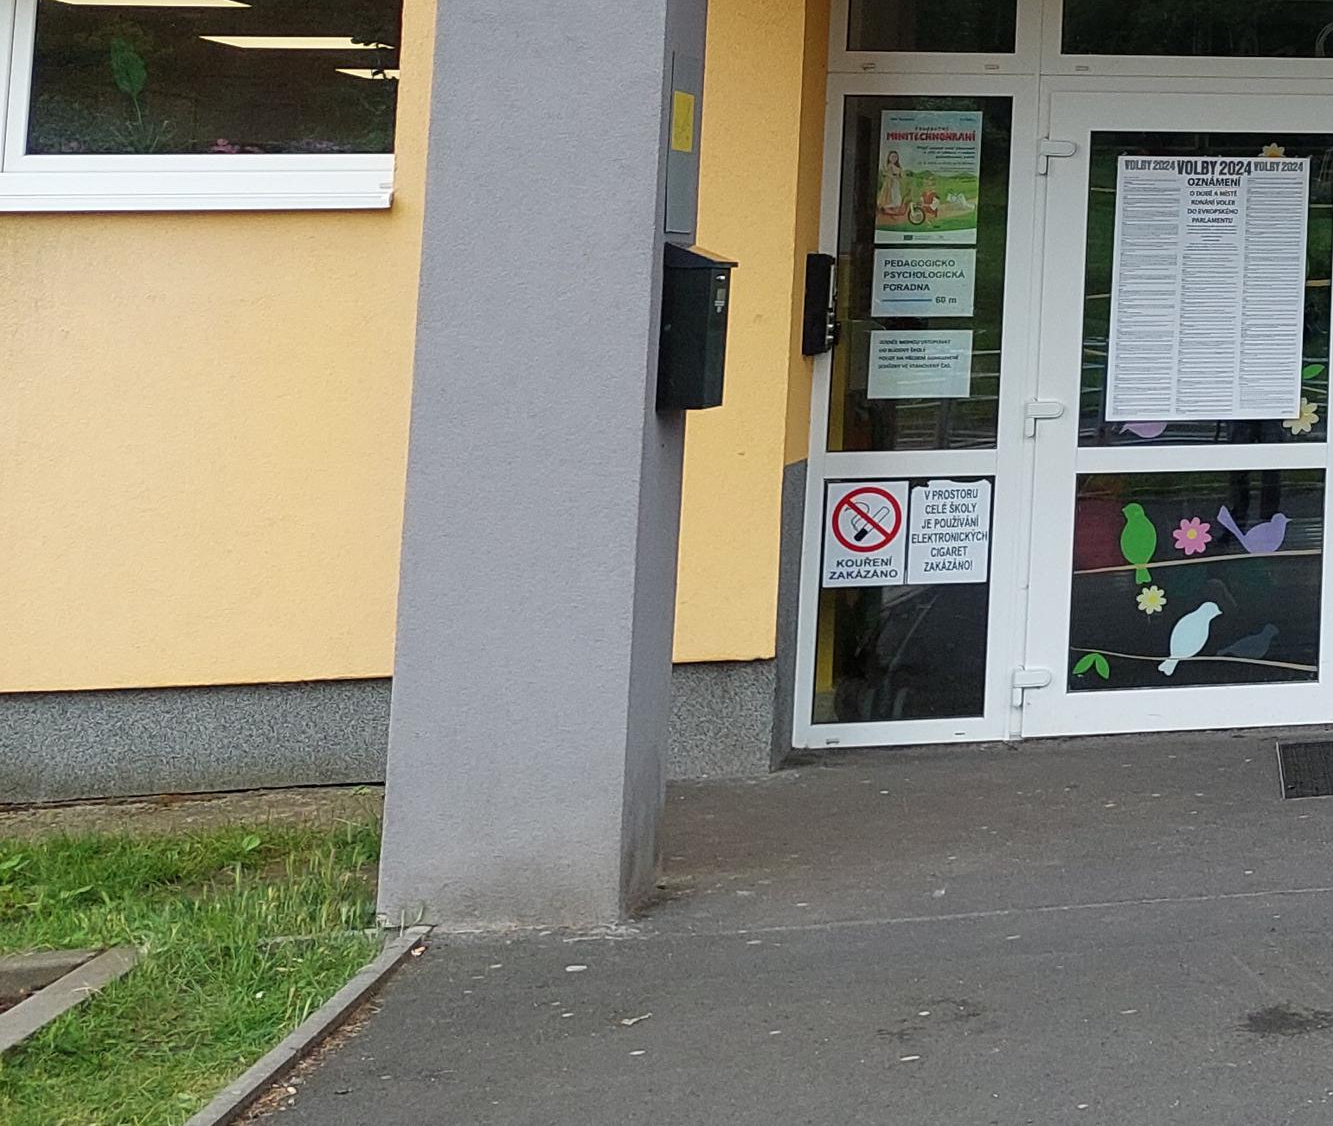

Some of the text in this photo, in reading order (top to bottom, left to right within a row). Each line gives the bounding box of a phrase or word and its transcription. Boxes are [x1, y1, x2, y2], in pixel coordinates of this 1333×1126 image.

[1124, 160, 1176, 171] VOLBY 2024
[1177, 160, 1252, 176] VOLBY 2024
[1254, 161, 1304, 172] VOLBY 2024
[1187, 176, 1241, 187] OZNÁMENÍ
[884, 259, 956, 268] PEDAGOGICKO
[883, 269, 965, 279] PSYCHOLOGICKÁ
[883, 283, 930, 291] PORADNA
[935, 296, 946, 304] 60
[924, 488, 979, 500] V PROSTORU
[924, 500, 978, 515] CELÉ ŠKOLY
[921, 515, 980, 529] JE POUŽÍVÁNÍ
[911, 529, 988, 544] ELEKTRONICKÝCH
[930, 545, 968, 558] CIGARET
[836, 555, 893, 568] KOUŘENÍ
[923, 559, 973, 573] ZAKÁZÁNO!
[828, 568, 898, 580] ZAKÁZÁNO
